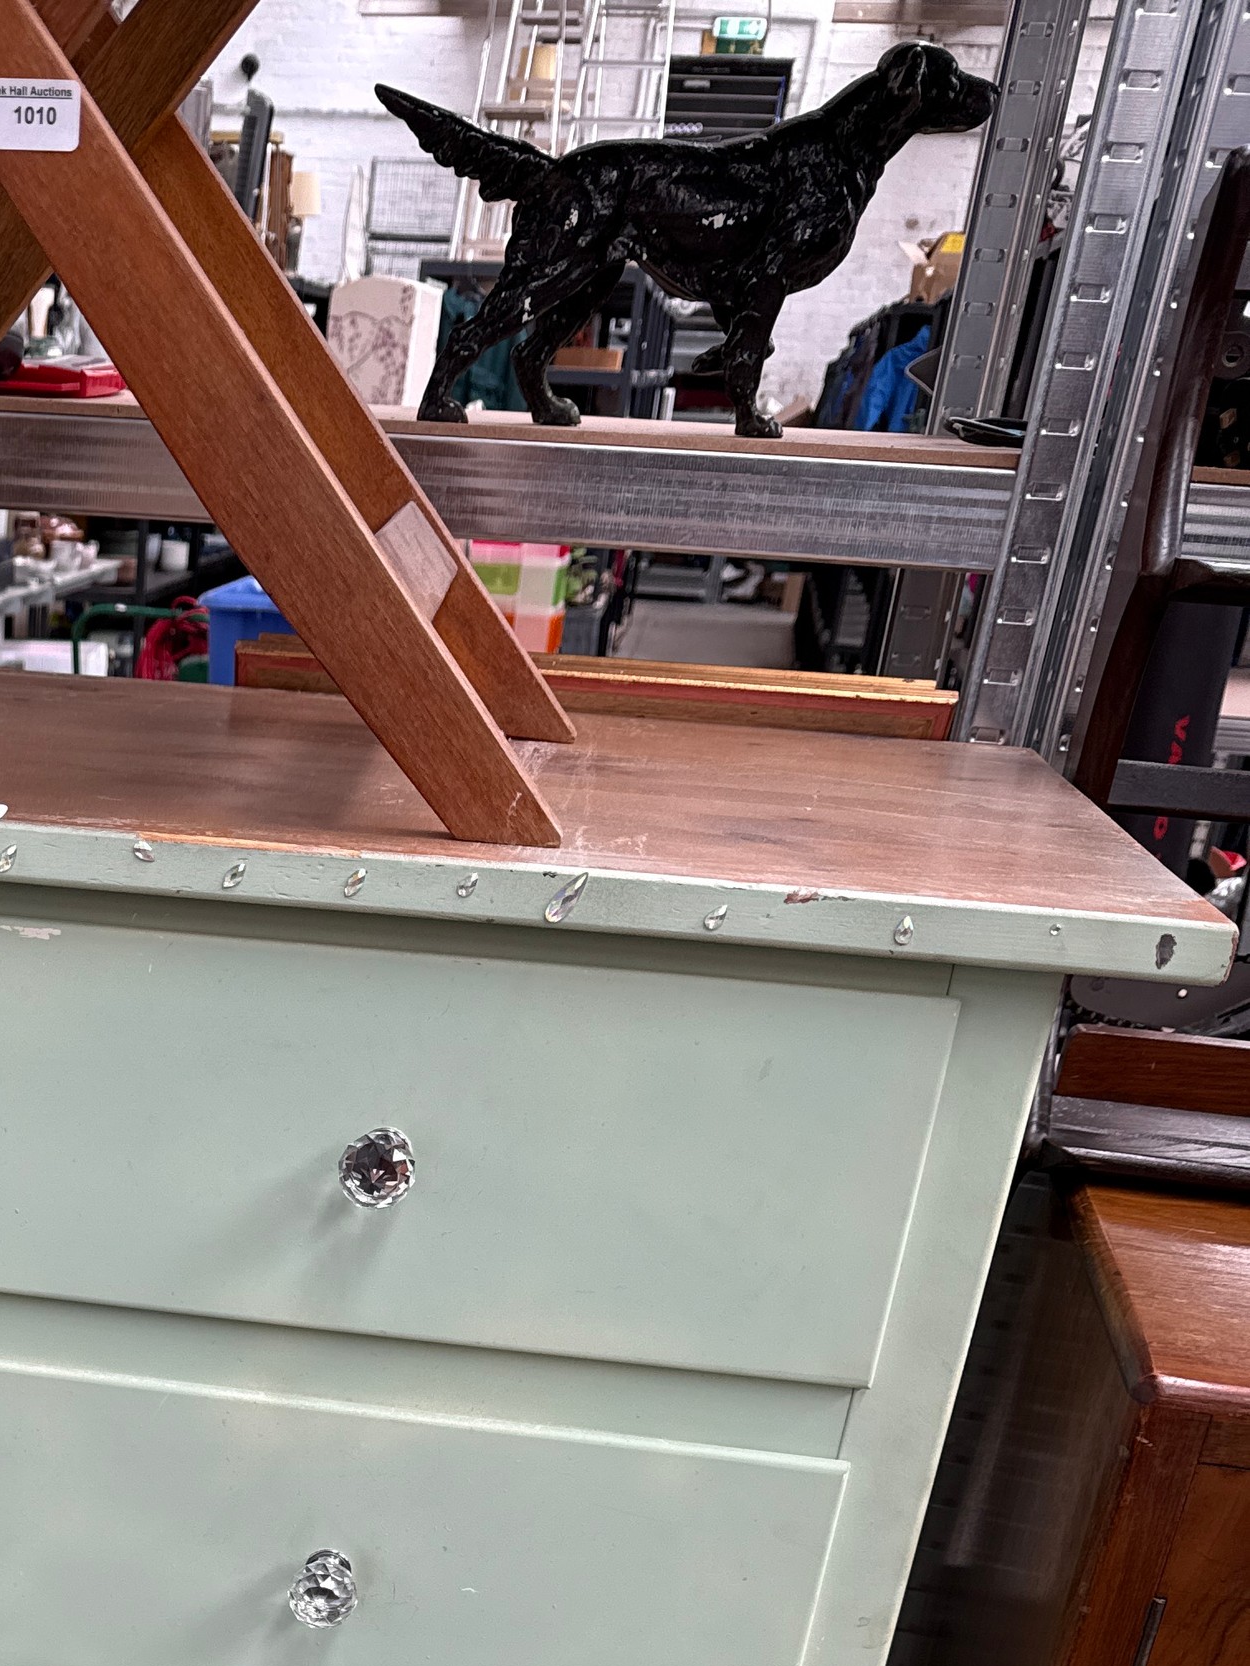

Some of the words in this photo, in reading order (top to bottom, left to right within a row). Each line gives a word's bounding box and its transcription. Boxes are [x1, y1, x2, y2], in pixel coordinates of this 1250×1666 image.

[9, 86, 28, 96] Hall
[30, 86, 72, 97] Auctions
[13, 105, 57, 125] 1010
